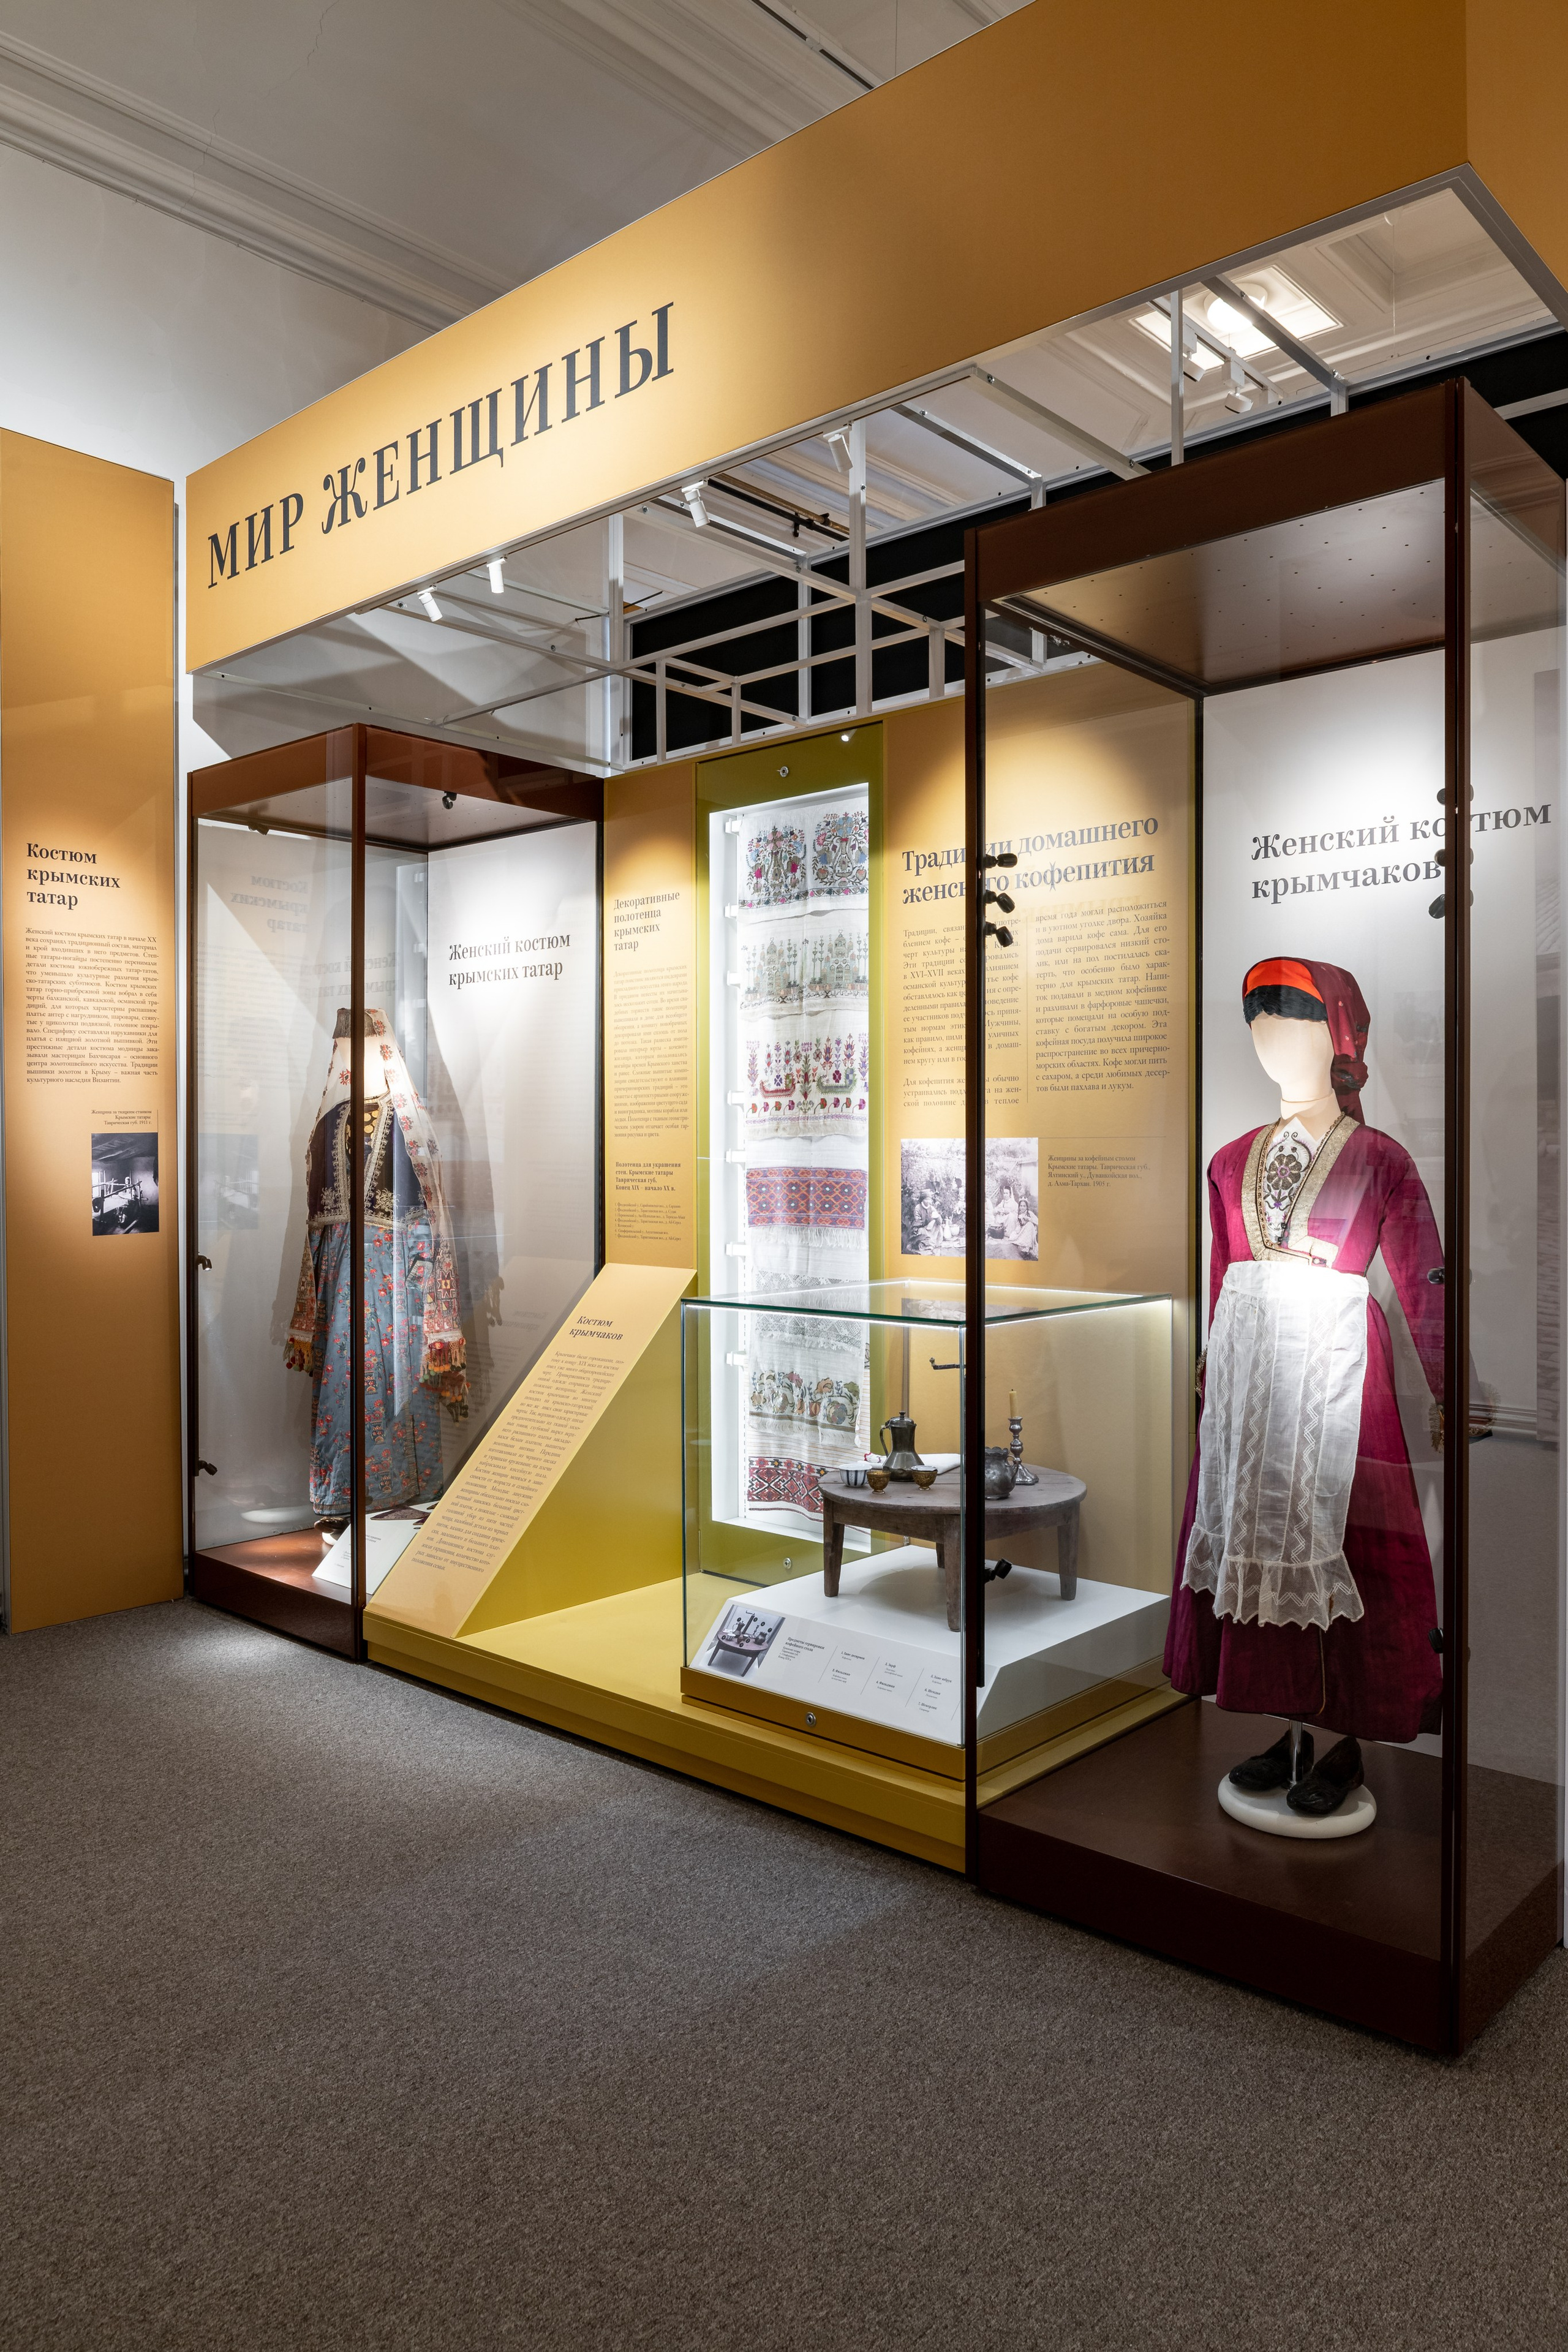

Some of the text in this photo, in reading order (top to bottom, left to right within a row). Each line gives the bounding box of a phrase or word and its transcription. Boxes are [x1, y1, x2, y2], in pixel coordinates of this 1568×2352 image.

[208, 302, 674, 589] МИР ЖЕНЩИНЫ
[1251, 804, 1551, 860] Женский котюм
[26, 843, 97, 864] Костюм
[902, 816, 1159, 876] Традиии домашнего
[26, 869, 120, 888] крымских
[1014, 854, 1156, 892] кофепития
[1252, 858, 1443, 904] крымчаков
[26, 891, 78, 910] татар
[614, 892, 680, 911] Декоративные
[614, 909, 662, 923] полотенца
[1035, 914, 1057, 924] время
[1081, 908, 1104, 917] могли
[1107, 901, 1167, 916] расположиться
[25, 927, 53, 935] Женский
[614, 924, 660, 940] крымских
[1048, 923, 1077, 934] уютном
[1079, 920, 1105, 931] уголке
[1106, 918, 1131, 927] двора.
[1134, 911, 1167, 922] Хозяйка
[1057, 934, 1083, 944] варила
[1087, 930, 1106, 941] кофе
[1133, 925, 1150, 936] Для
[448, 934, 570, 961] Женский костюм
[614, 941, 638, 952] татар
[1036, 948, 1061, 956] подачи
[1065, 942, 1116, 955] сервировался
[1120, 937, 1149, 948] низкий
[1104, 951, 1150, 961] постилалась
[40, 954, 87, 963] татары-ногайцы
[449, 962, 563, 990] крымских татар
[576, 1316, 613, 1327] Костюм
[569, 1329, 624, 1340] крымчаков
